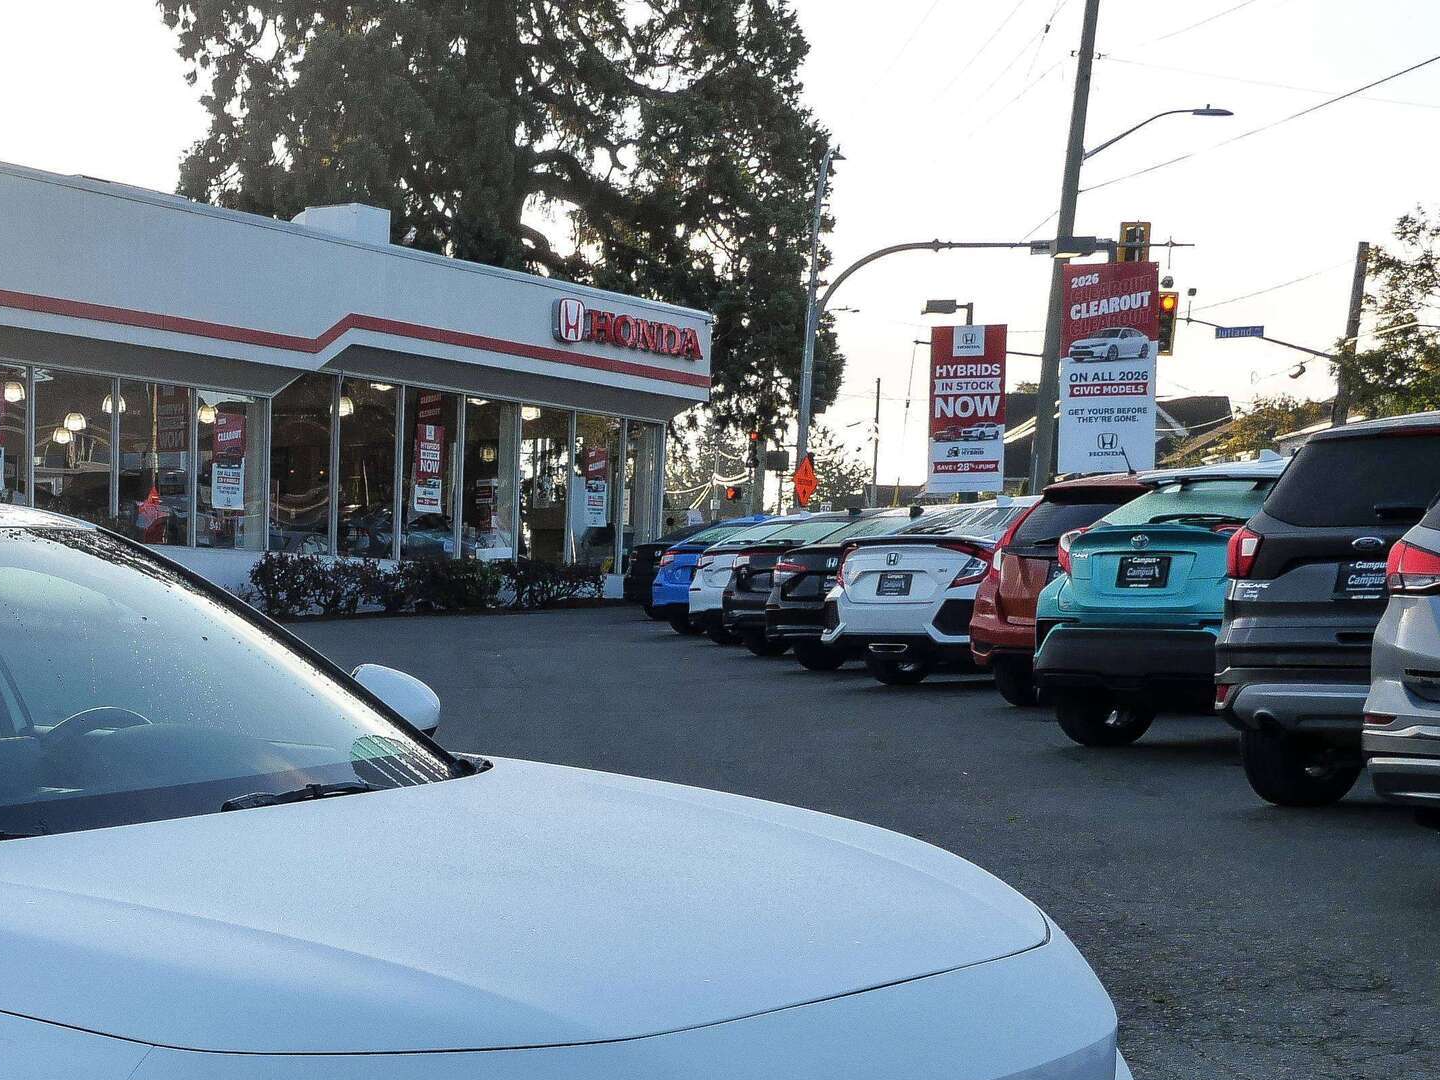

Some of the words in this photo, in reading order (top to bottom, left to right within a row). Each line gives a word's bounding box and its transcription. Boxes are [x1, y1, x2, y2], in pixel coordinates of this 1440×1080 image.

[1071, 273, 1099, 288] 2026
[1070, 291, 1152, 320] CLEAROUT
[588, 308, 703, 361] HONDA
[936, 364, 1001, 377] HYBRIDS
[1070, 372, 1088, 383] ON
[1092, 371, 1115, 381] ALL
[1119, 371, 1148, 381] 2026
[941, 382, 953, 391] IN
[956, 381, 994, 391] STOCK
[1073, 386, 1101, 395] CIVIC
[1102, 385, 1144, 394] MODELS
[935, 395, 1000, 418] NOW
[1077, 416, 1112, 424] THEY'RE
[420, 460, 440, 473] NOW
[1127, 567, 1154, 577] Campus
[1347, 574, 1385, 586] Campus
